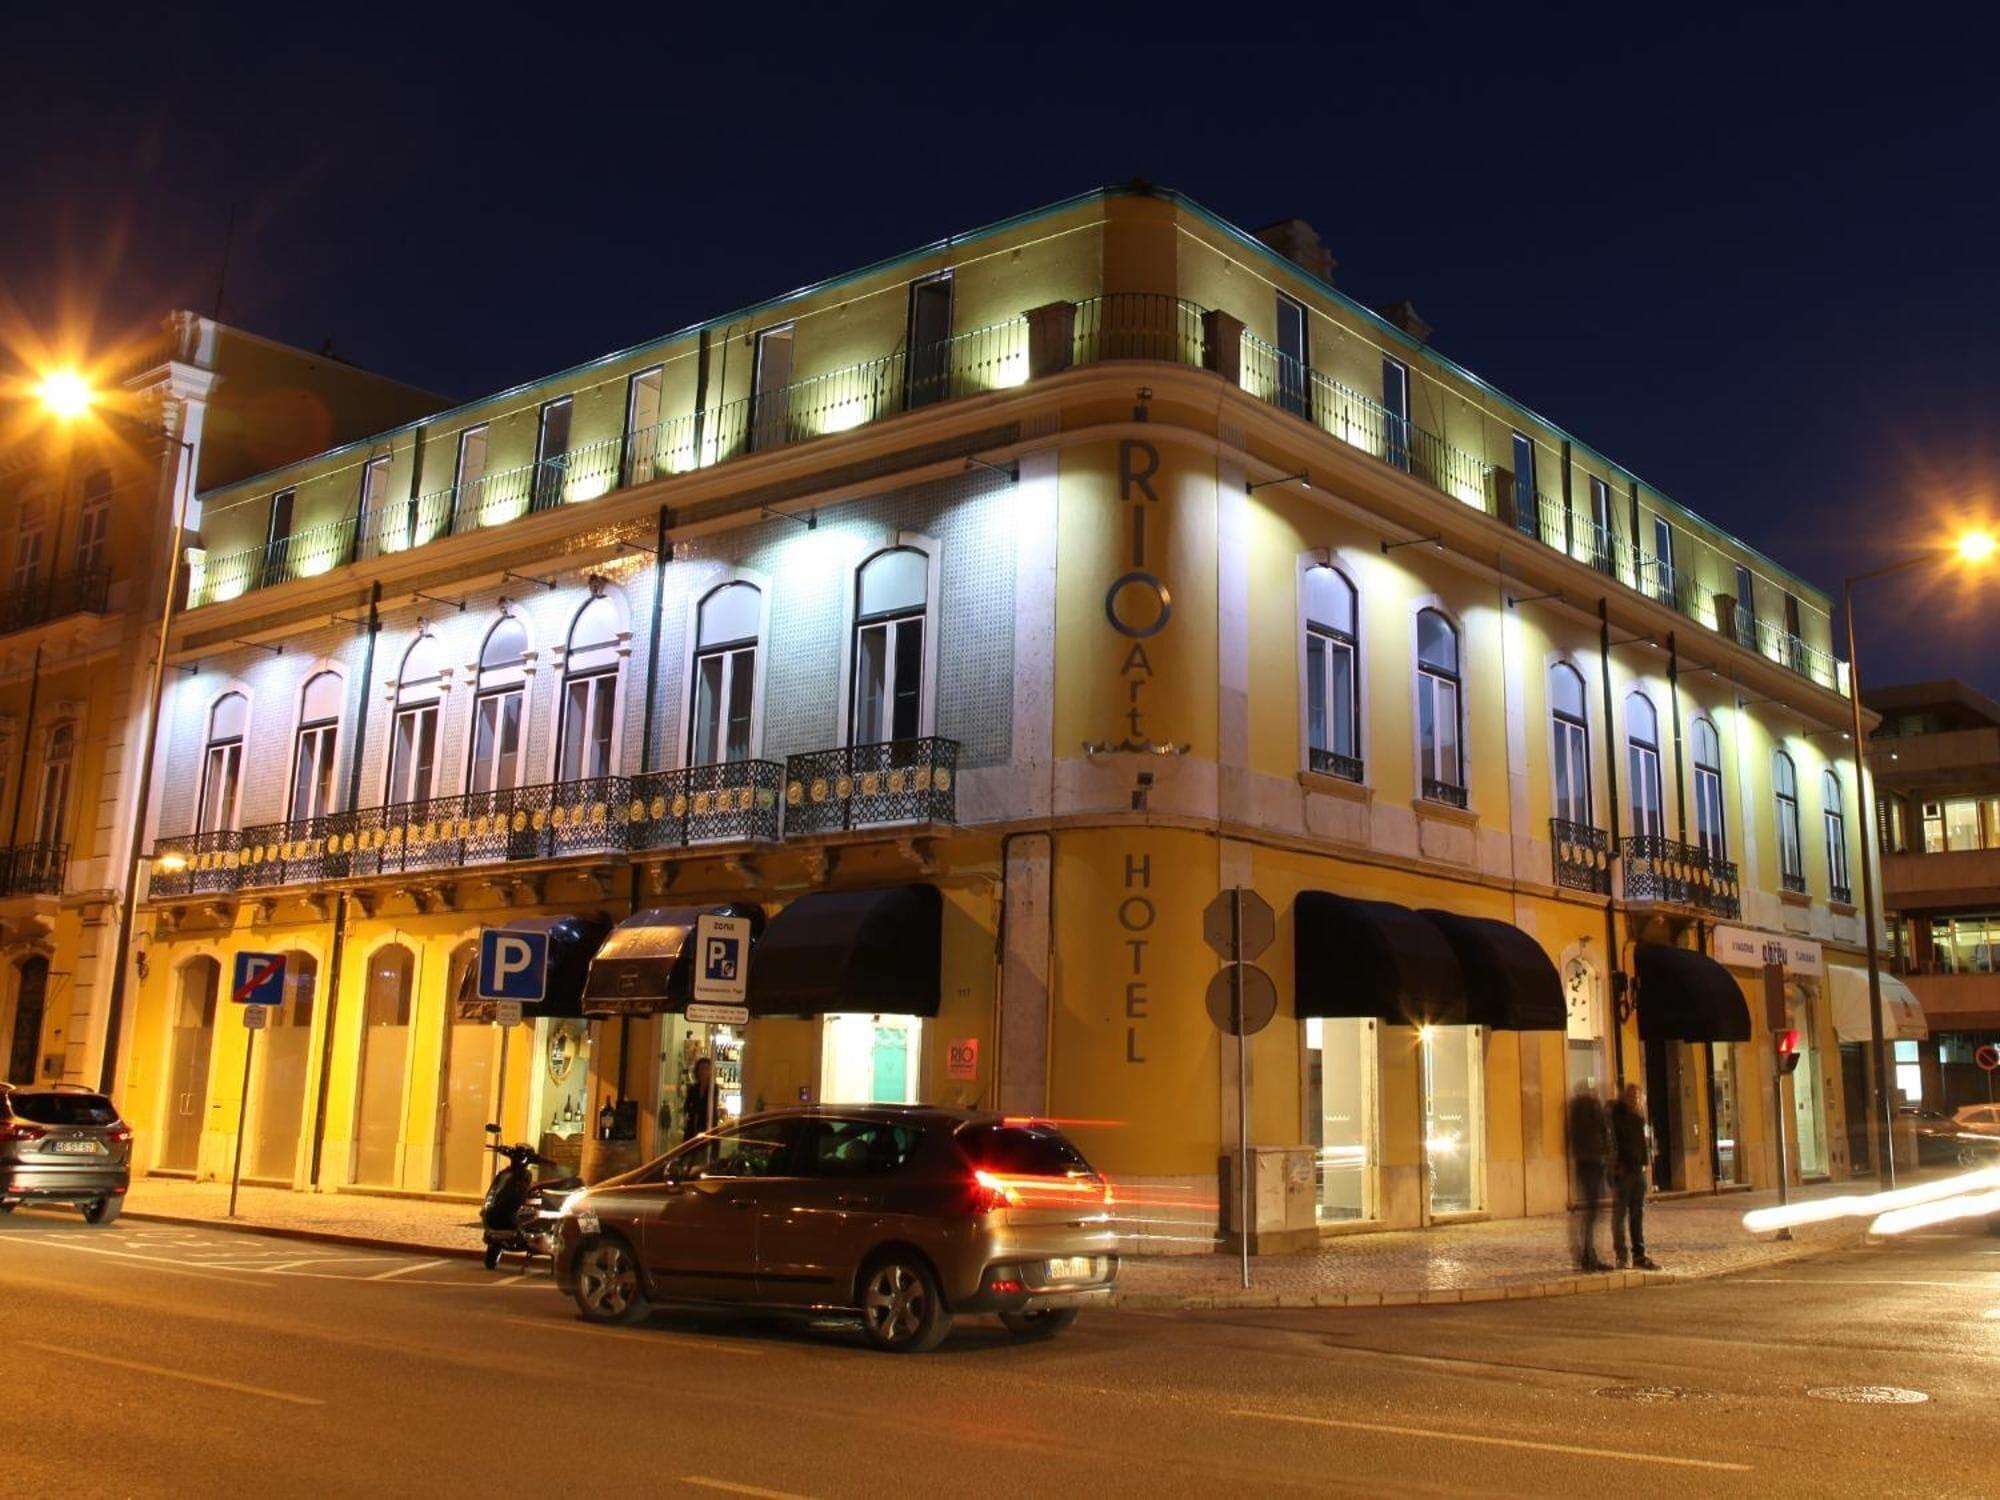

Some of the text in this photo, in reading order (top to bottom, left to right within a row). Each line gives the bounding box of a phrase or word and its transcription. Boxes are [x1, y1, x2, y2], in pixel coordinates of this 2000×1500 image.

[1104, 438, 1172, 1064] RIO Art HOTEL
[493, 937, 532, 992] P
[708, 940, 727, 969] P
[244, 957, 275, 999] P
[950, 1046, 974, 1063] RIO
